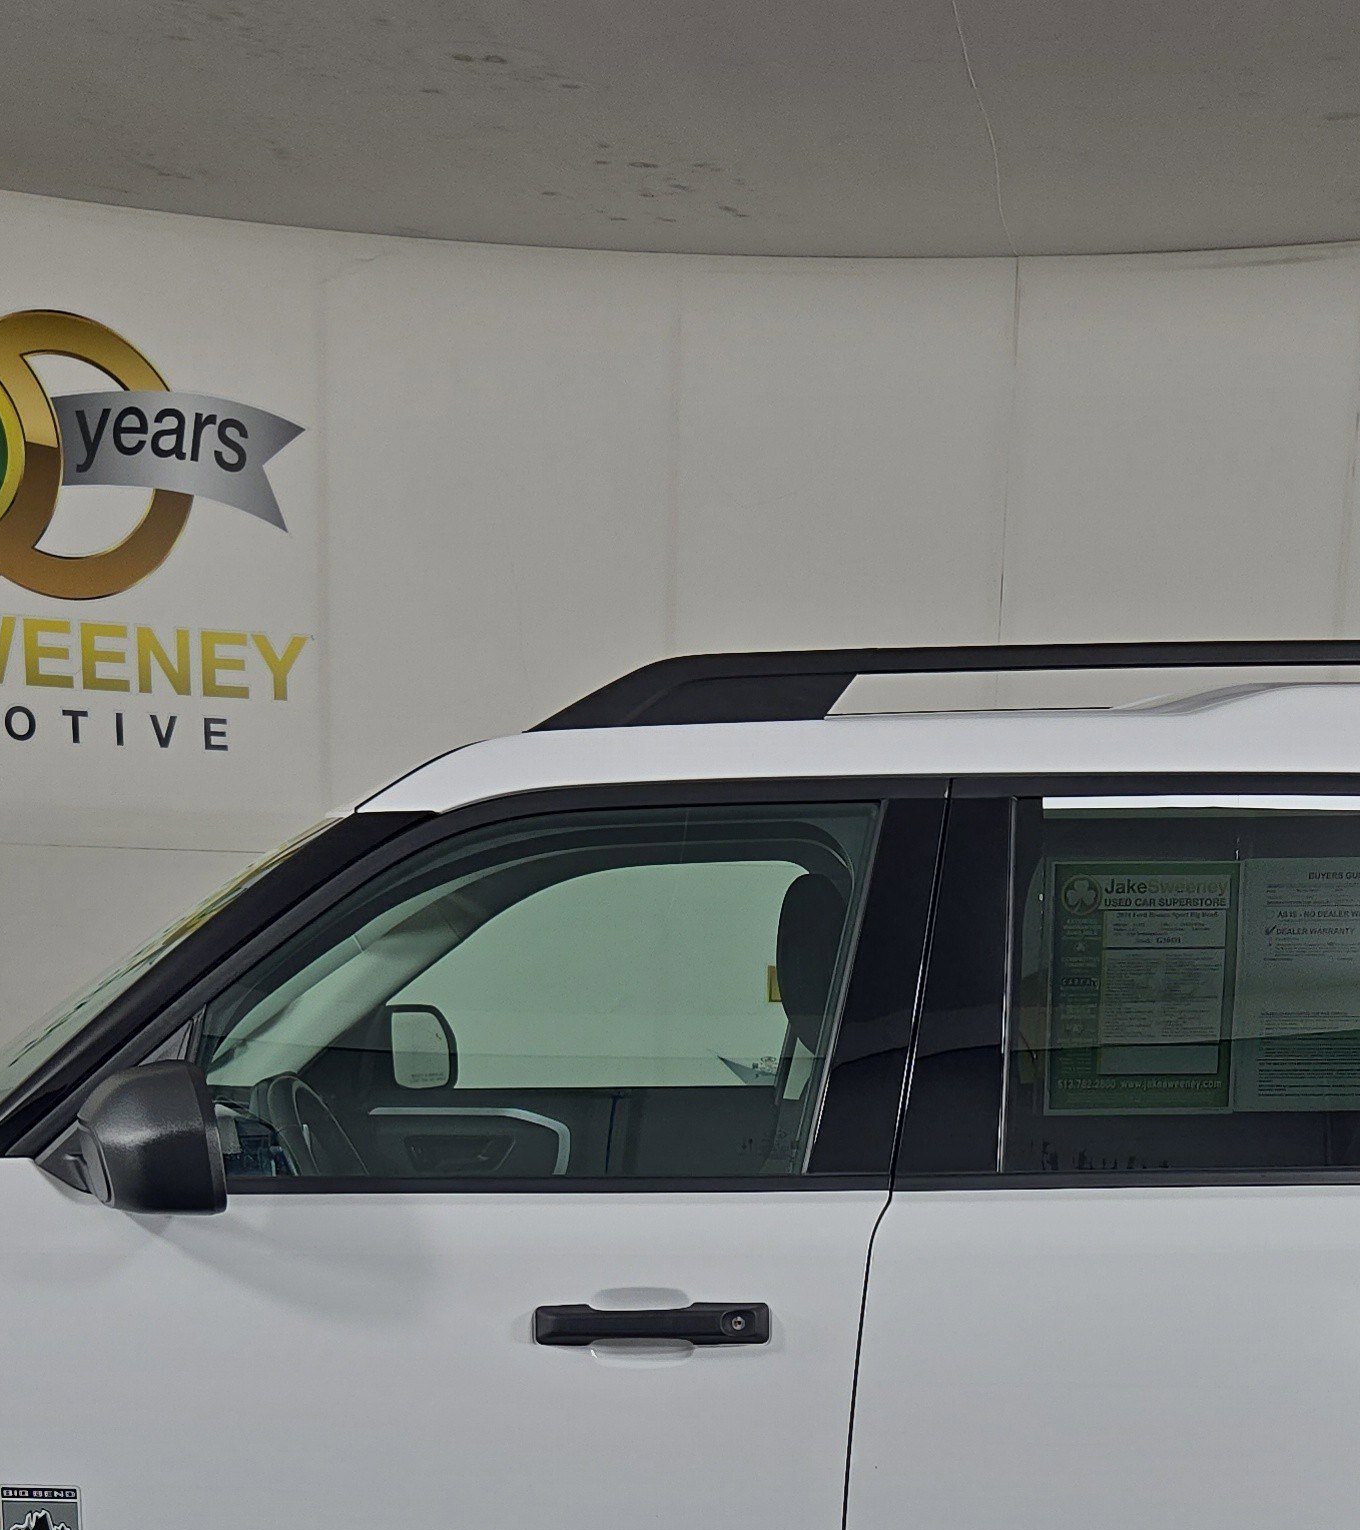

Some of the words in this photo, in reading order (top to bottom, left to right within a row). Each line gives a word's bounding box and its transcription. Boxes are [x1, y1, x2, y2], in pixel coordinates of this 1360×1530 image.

[74, 403, 251, 474] years
[1308, 871, 1344, 880] BUYERS
[1104, 898, 1132, 907] USED
[1134, 898, 1156, 907] CAR
[1158, 897, 1227, 907] SUPERSTORE
